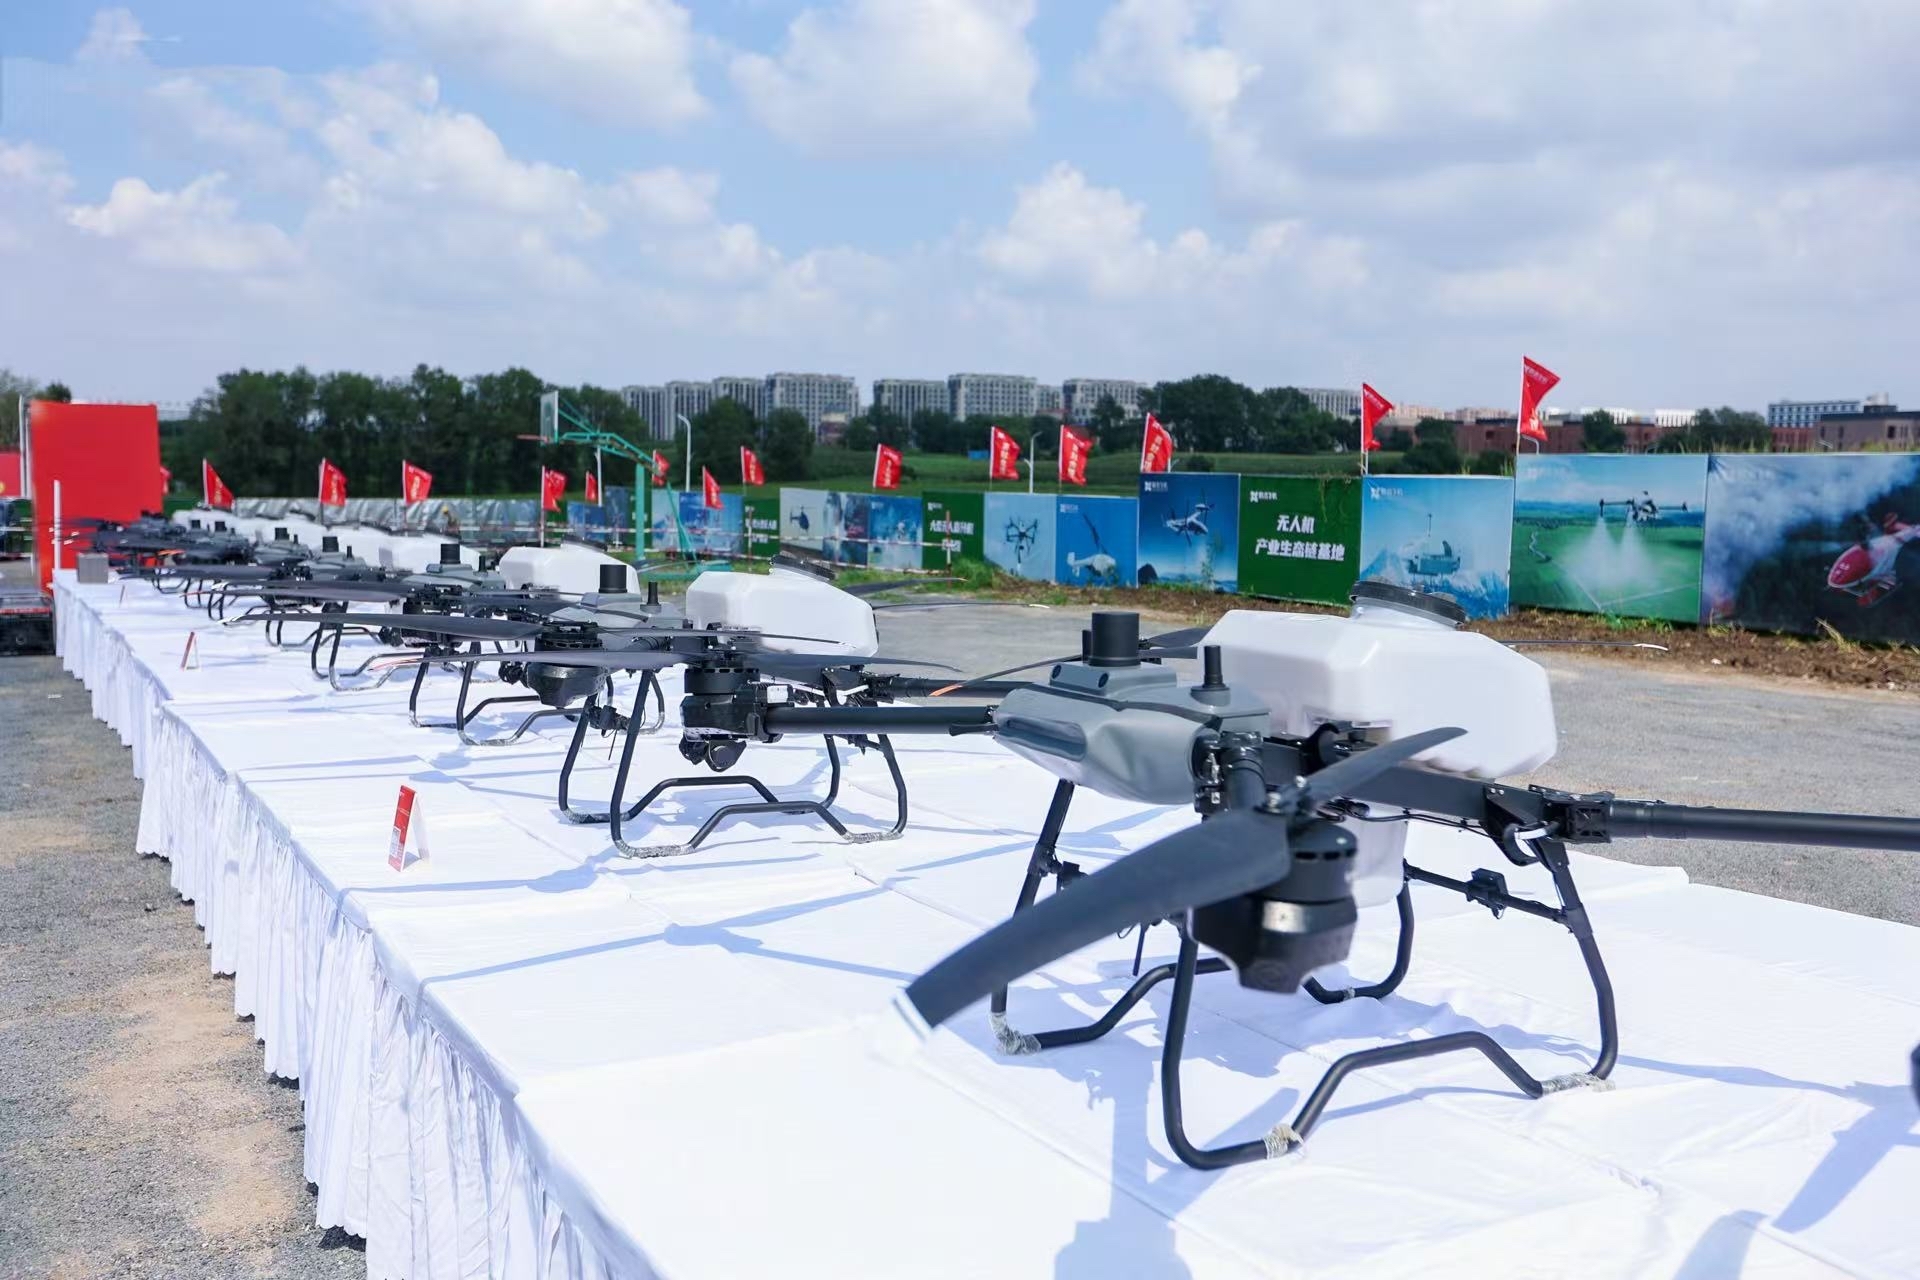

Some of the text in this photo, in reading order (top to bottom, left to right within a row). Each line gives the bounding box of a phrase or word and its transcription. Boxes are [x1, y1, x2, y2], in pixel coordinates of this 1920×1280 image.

[1277, 515, 1315, 534] 无人机
[1255, 538, 1345, 561] 产业生态链基地
